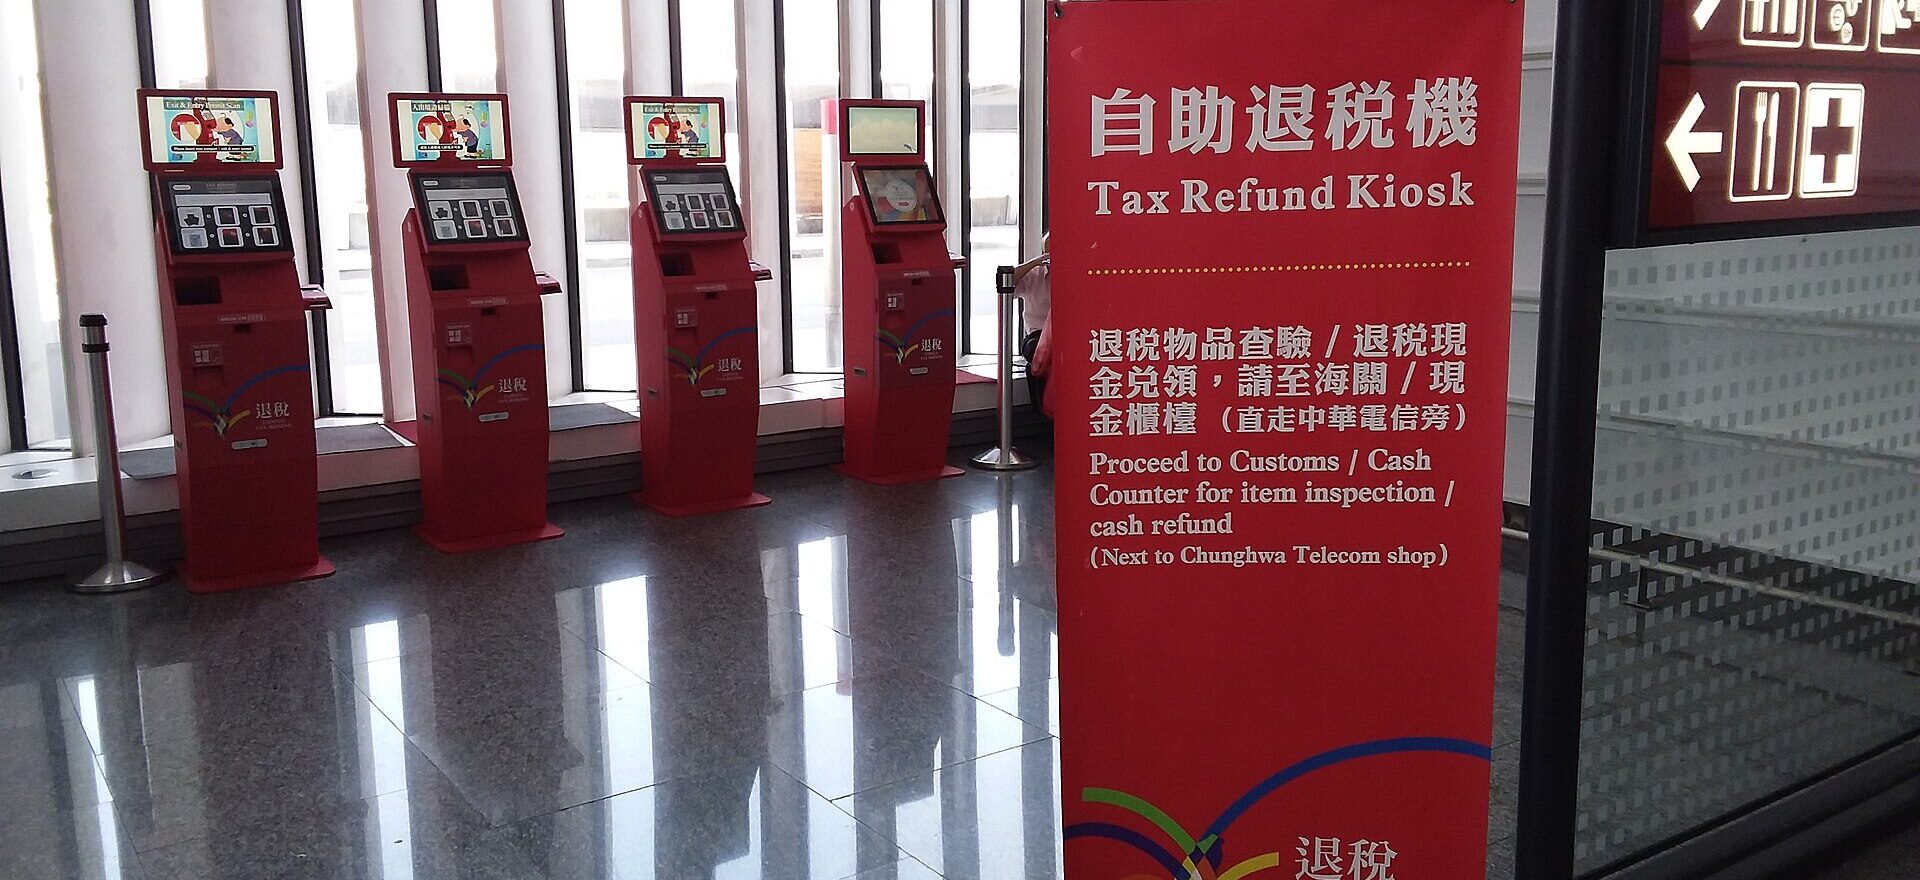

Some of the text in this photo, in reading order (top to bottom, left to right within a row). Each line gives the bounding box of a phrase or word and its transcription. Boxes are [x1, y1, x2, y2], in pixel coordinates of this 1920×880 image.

[1087, 171, 1475, 216] Tax Refund Kiosk
[1428, 359, 1466, 395] 現
[1088, 447, 1432, 476] Proceed to Customs / Cash
[1089, 479, 1455, 508] Counter for item inspection /
[1090, 511, 1234, 537] cash refund
[1090, 543, 1448, 569] (Next to Chunghwa Telecom shop)
